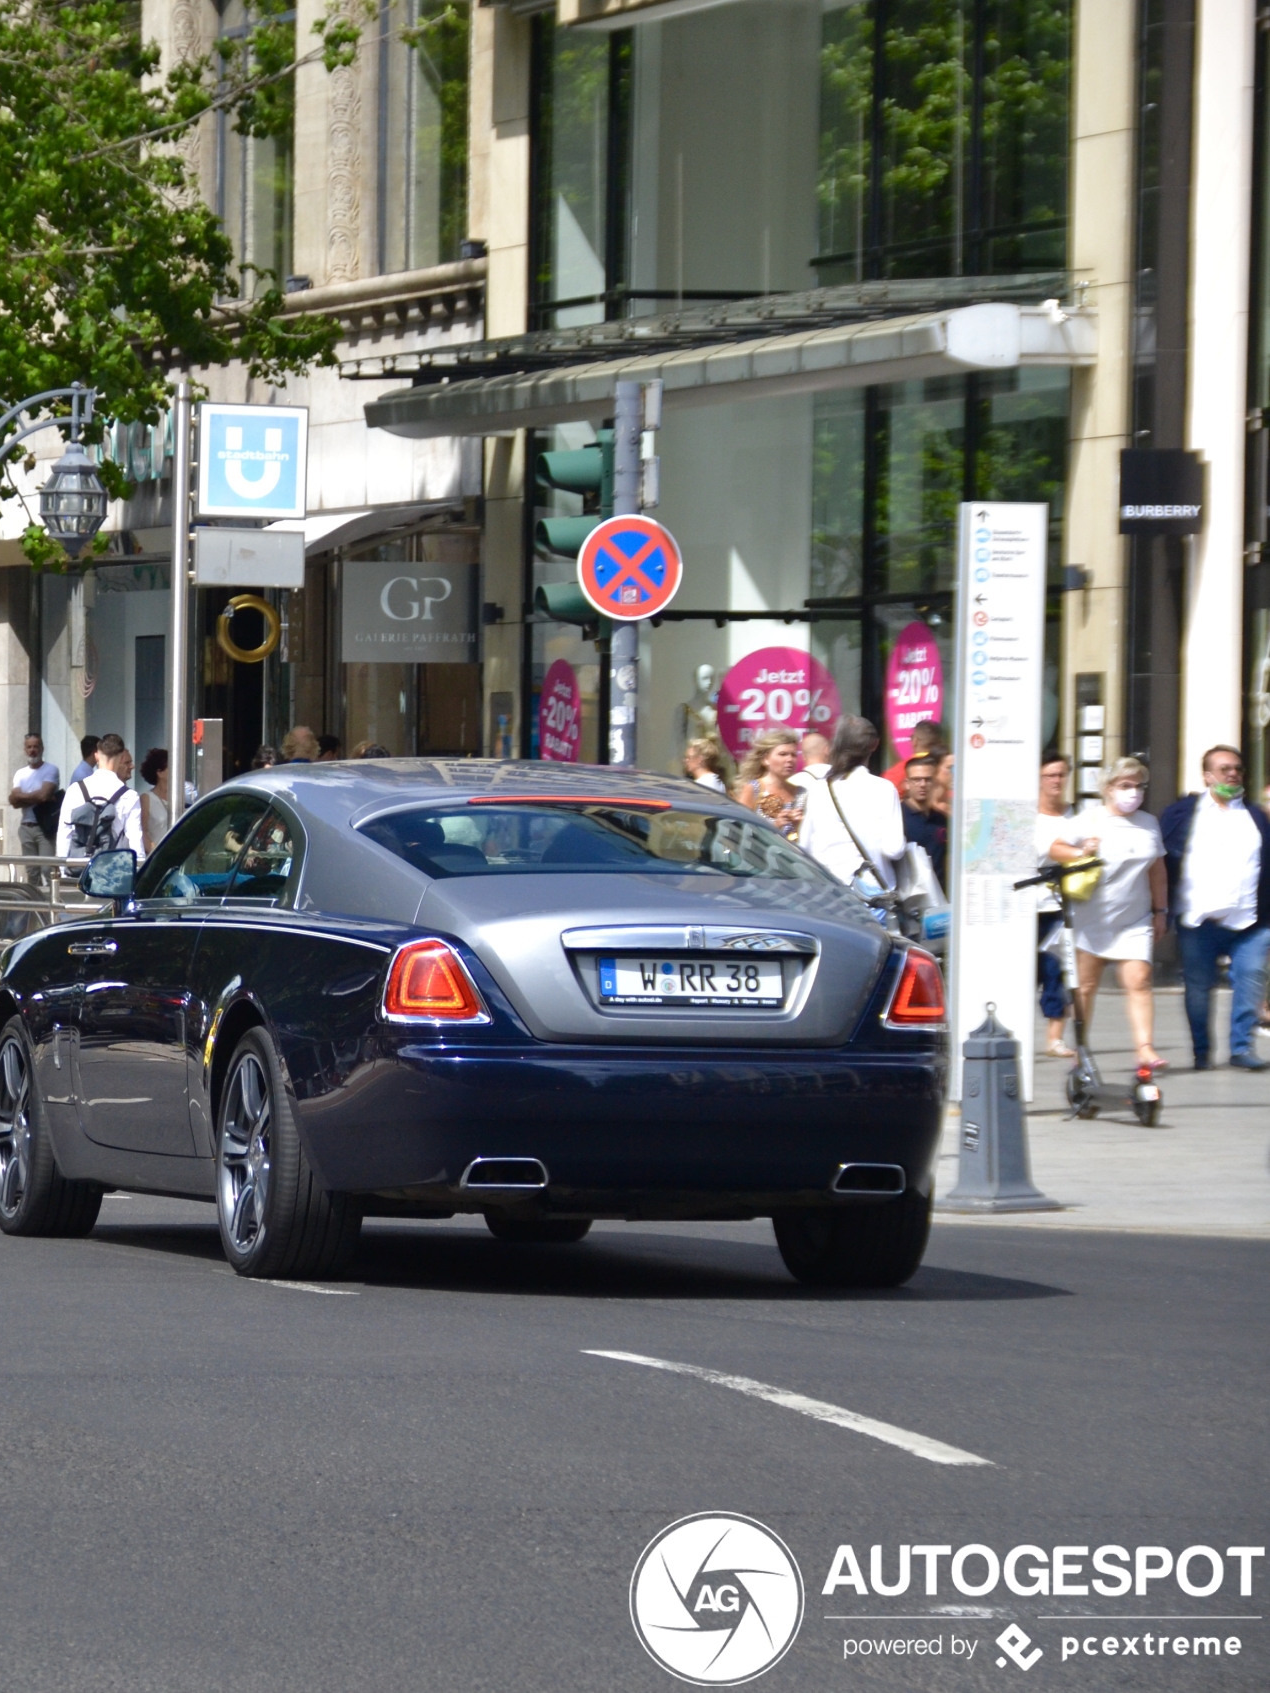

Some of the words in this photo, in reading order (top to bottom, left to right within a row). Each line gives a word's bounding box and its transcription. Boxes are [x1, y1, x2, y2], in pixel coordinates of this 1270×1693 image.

[217, 450, 289, 461] stadtbahn
[1123, 505, 1201, 517] BURBERRY
[380, 576, 452, 621] GP
[355, 633, 409, 643] GALERIE
[413, 633, 476, 643] PAFFRATH
[903, 647, 927, 664] Jetzt
[755, 669, 806, 684] Jetzt
[889, 667, 939, 705] -20%
[726, 688, 831, 722] -20%
[542, 696, 579, 740] -20%
[605, 981, 613, 989] D
[640, 962, 657, 991] W
[680, 963, 718, 992] RR
[726, 964, 760, 993] 38
